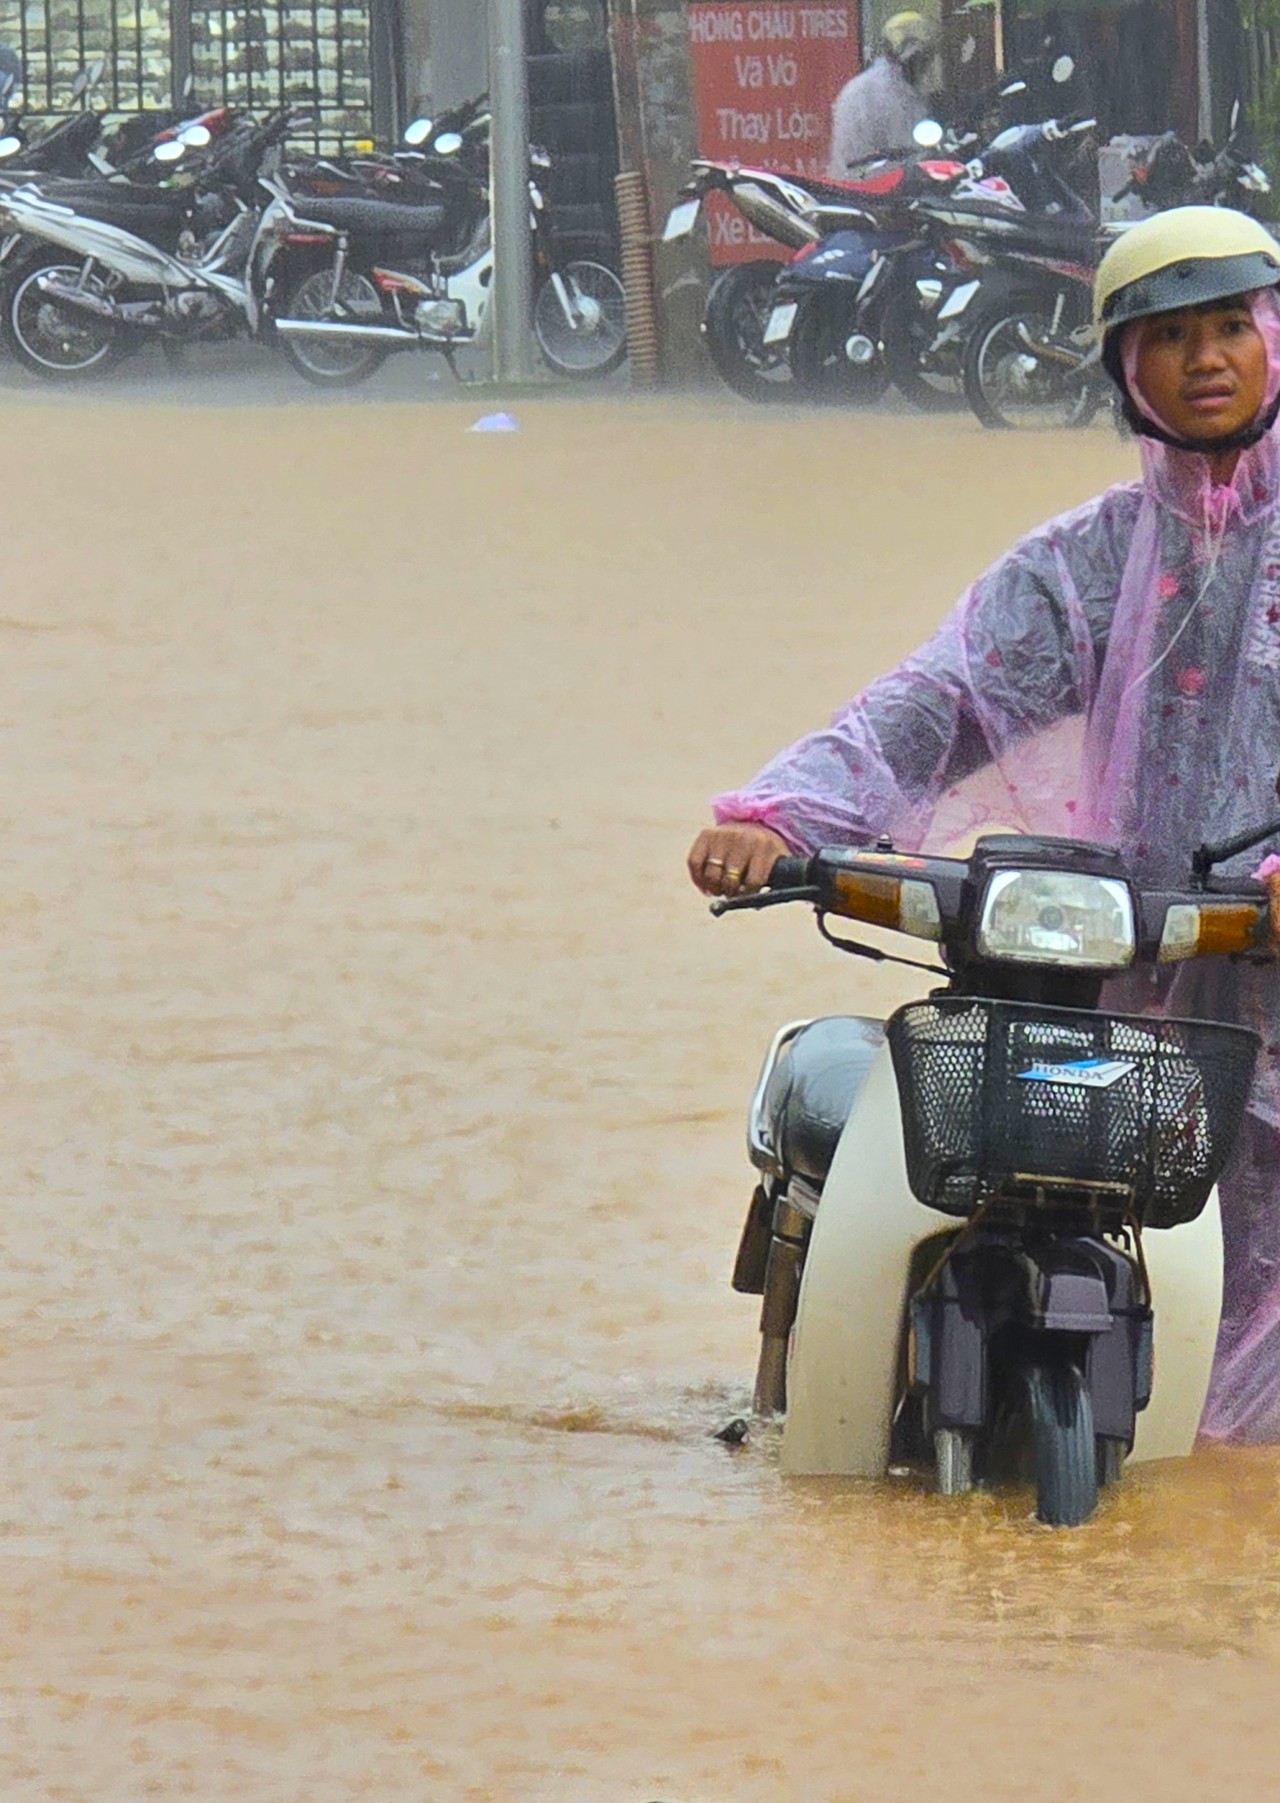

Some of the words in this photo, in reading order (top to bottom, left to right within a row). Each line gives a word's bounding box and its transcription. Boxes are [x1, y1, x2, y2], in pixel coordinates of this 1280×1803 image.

[800, 8, 849, 39] TIRES
[716, 107, 771, 144] Thay
[714, 212, 743, 246] Xe
[1036, 1064, 1104, 1081] HONDA
